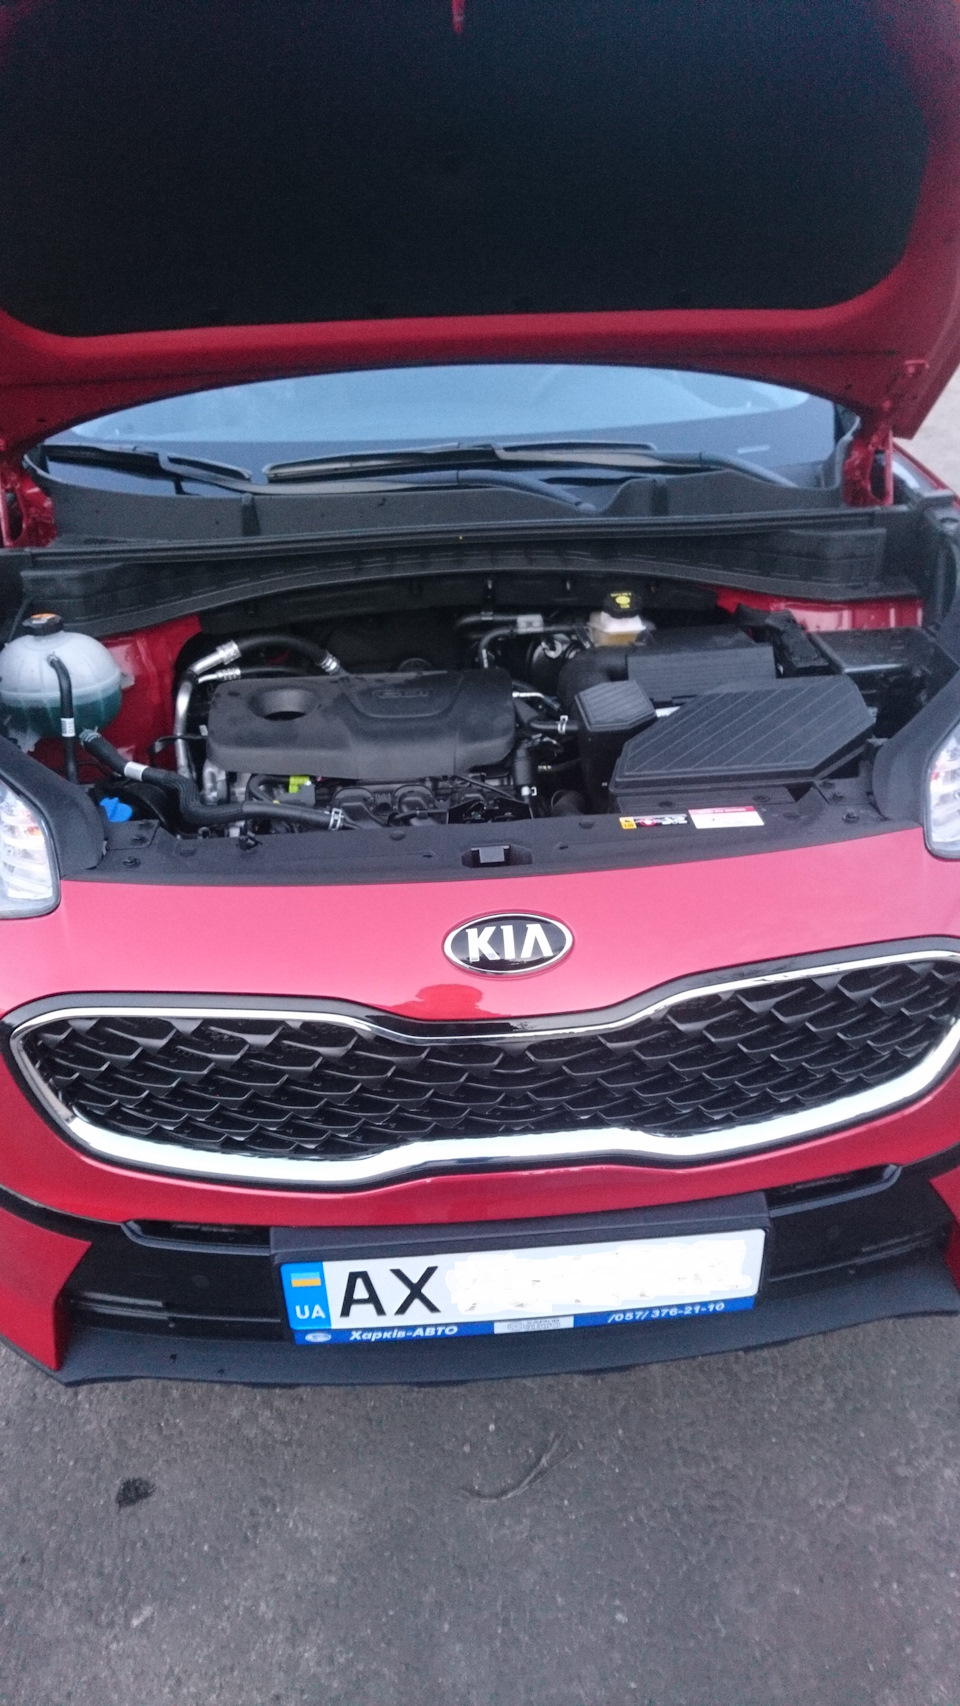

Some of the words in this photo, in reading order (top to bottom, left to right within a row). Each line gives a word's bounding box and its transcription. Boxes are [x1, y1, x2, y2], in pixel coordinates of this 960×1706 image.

[465, 923, 554, 963] KIA
[340, 1266, 441, 1318] AX
[295, 1304, 326, 1320] UA
[651, 1302, 725, 1318] 376-21-10
